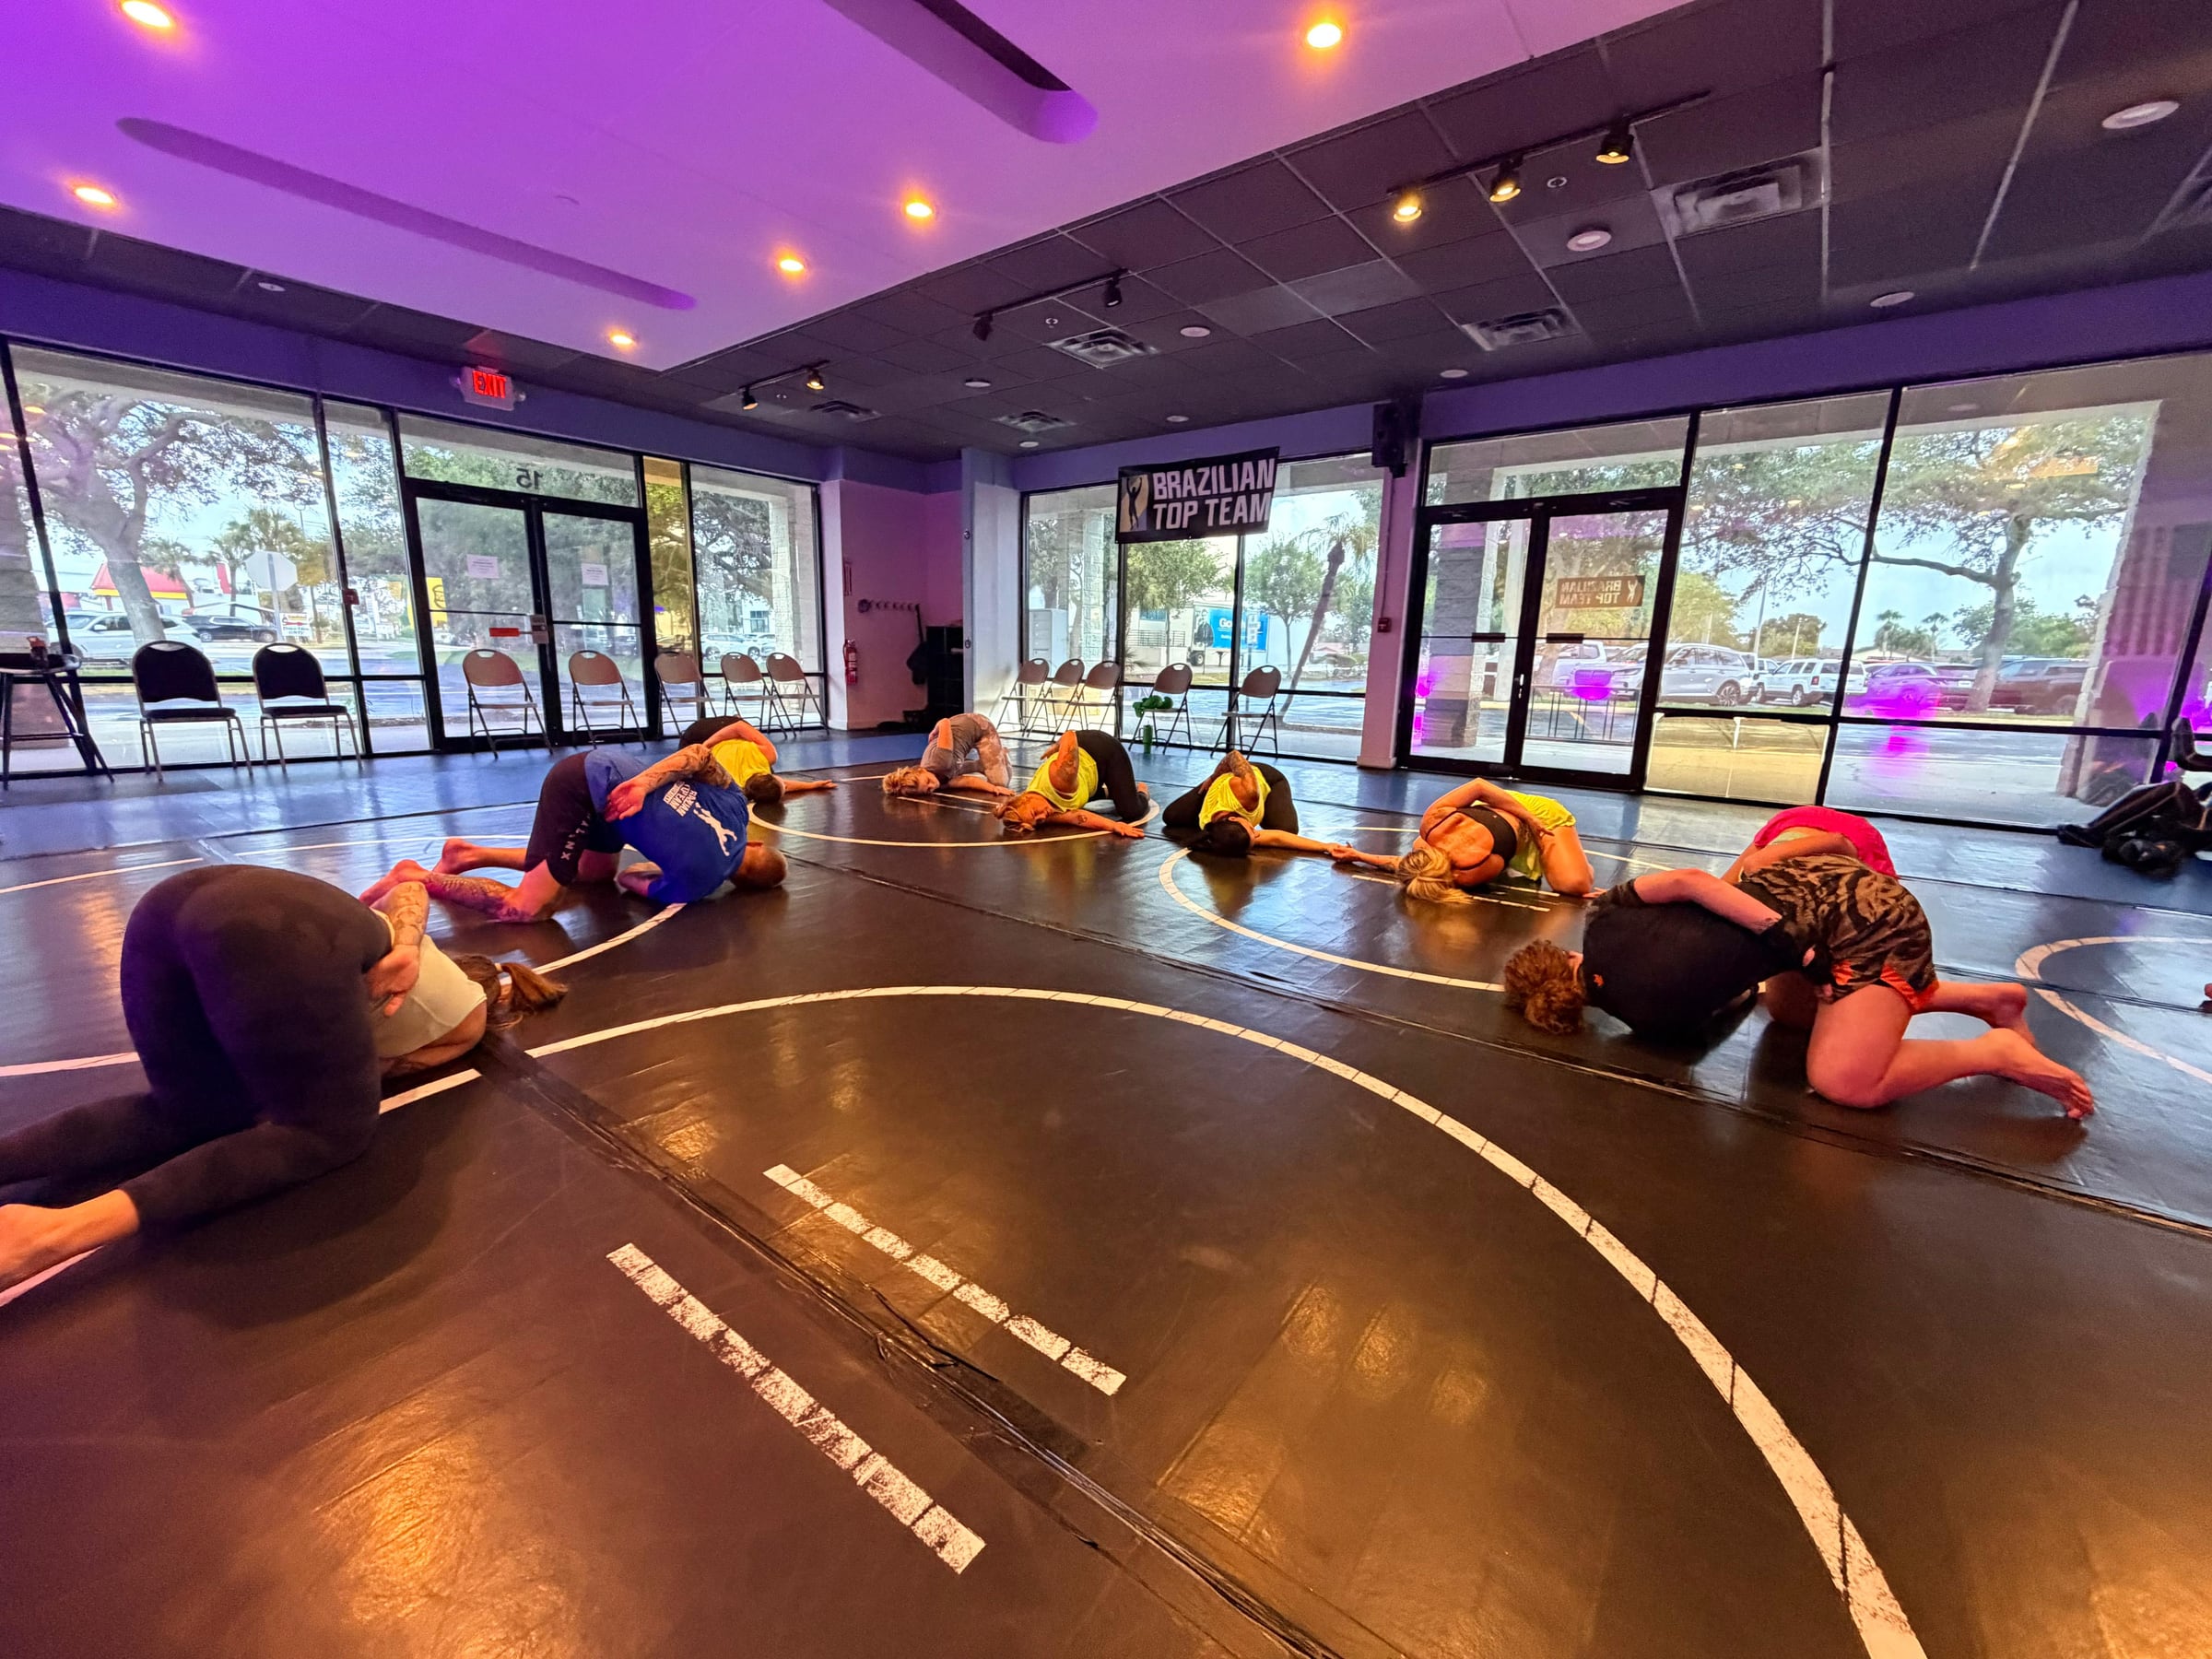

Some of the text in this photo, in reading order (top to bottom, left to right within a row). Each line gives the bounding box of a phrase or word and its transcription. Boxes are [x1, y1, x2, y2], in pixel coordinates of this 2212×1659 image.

[472, 370, 507, 398] EXIT
[1152, 458, 1276, 500] BRAZILIAN
[1153, 492, 1273, 530] TOP TEAM
